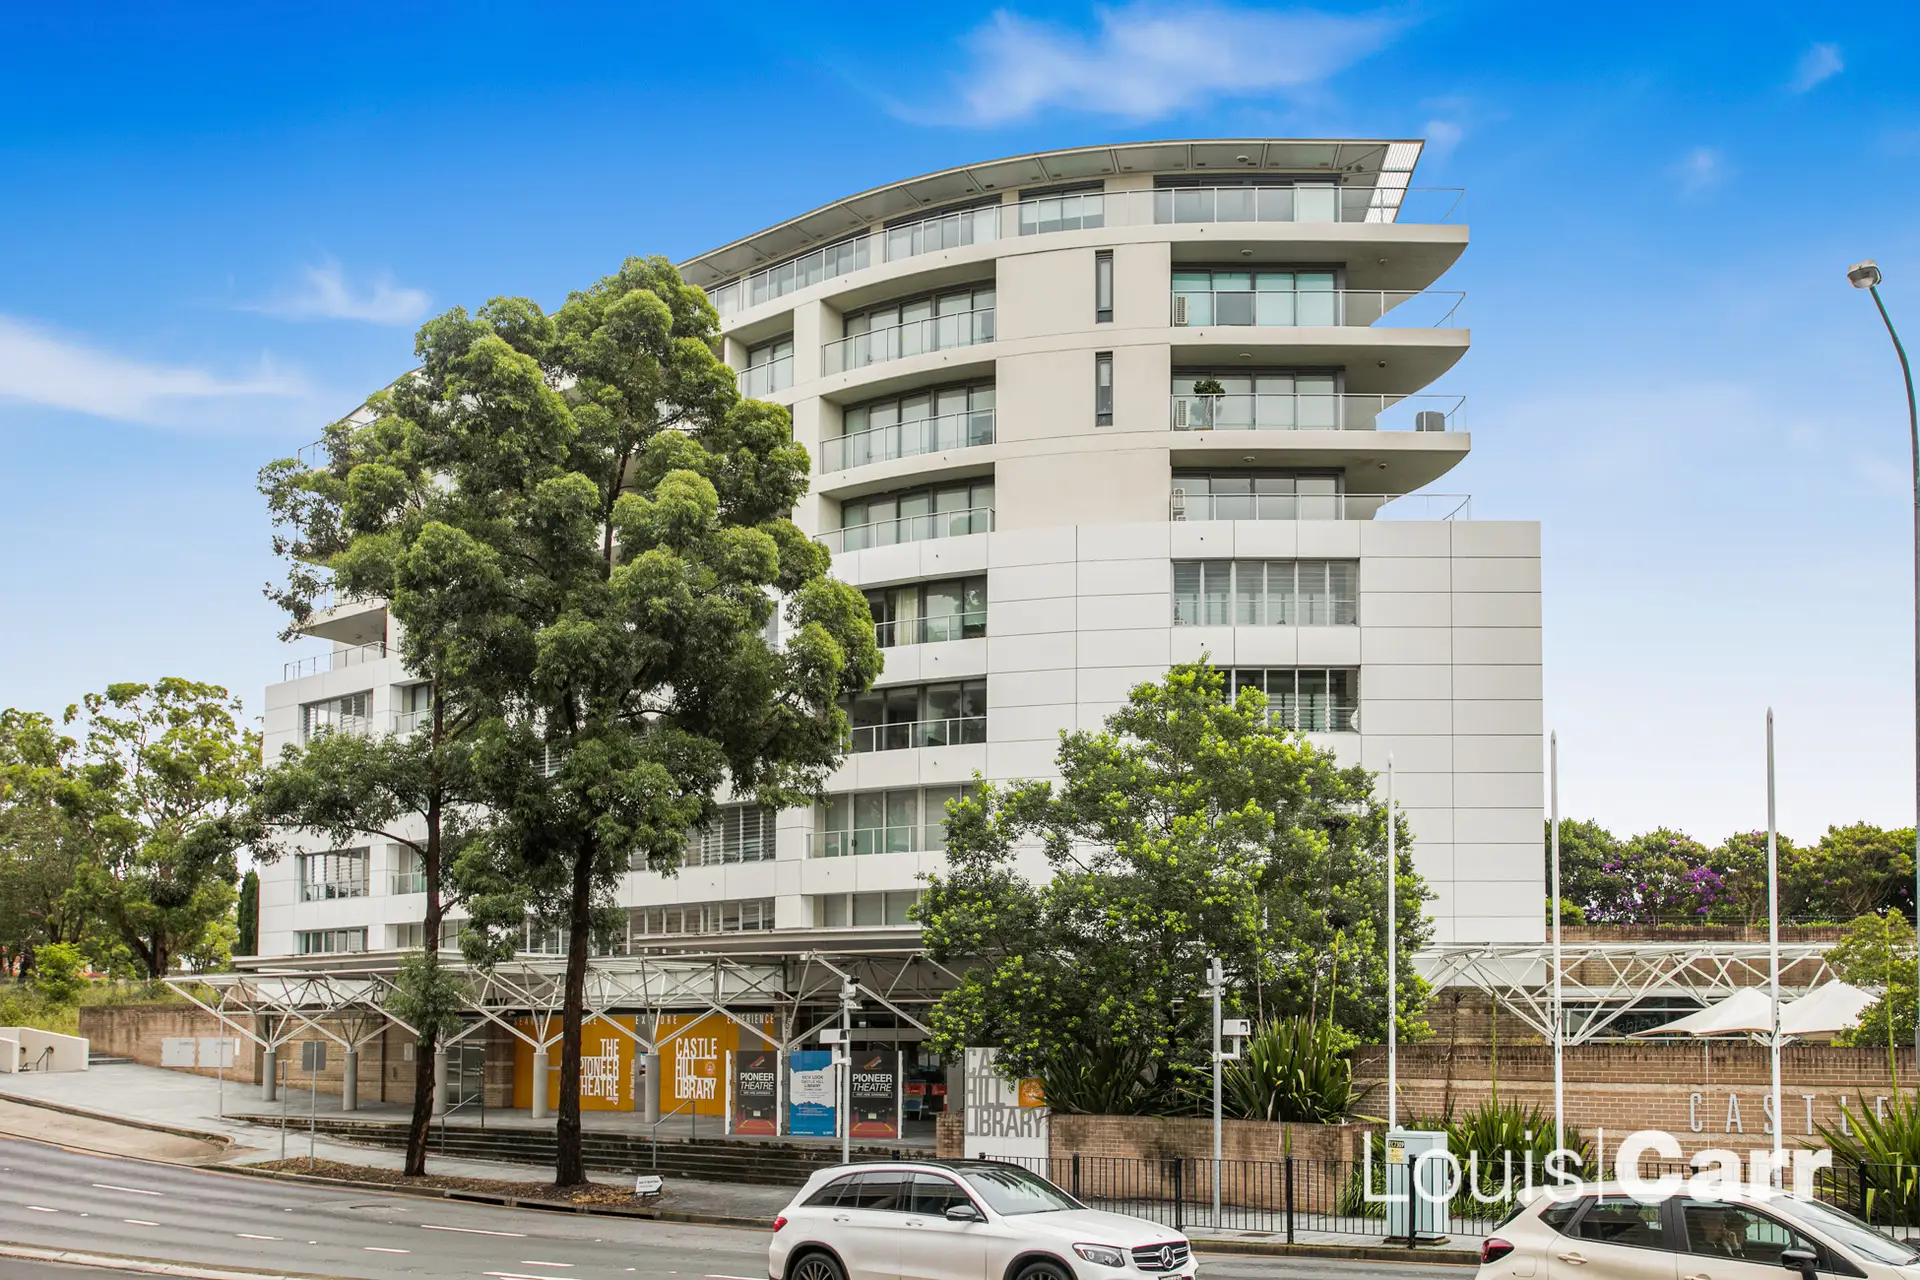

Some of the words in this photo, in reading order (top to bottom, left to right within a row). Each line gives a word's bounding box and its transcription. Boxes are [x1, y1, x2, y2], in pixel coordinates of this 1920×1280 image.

[600, 1038, 620, 1058] THE
[675, 1037, 718, 1059] CASTLE
[675, 1058, 697, 1079] HILL
[740, 1072, 775, 1082] PIONEER
[852, 1073, 893, 1083] PIONEER
[580, 1075, 620, 1097] HEATRE
[675, 1078, 717, 1100] LIBRARY
[740, 1081, 774, 1091] THEATRE
[852, 1082, 892, 1092] THEATRE
[966, 1076, 1006, 1107] HILL
[965, 1106, 1046, 1138] LIBRARY
